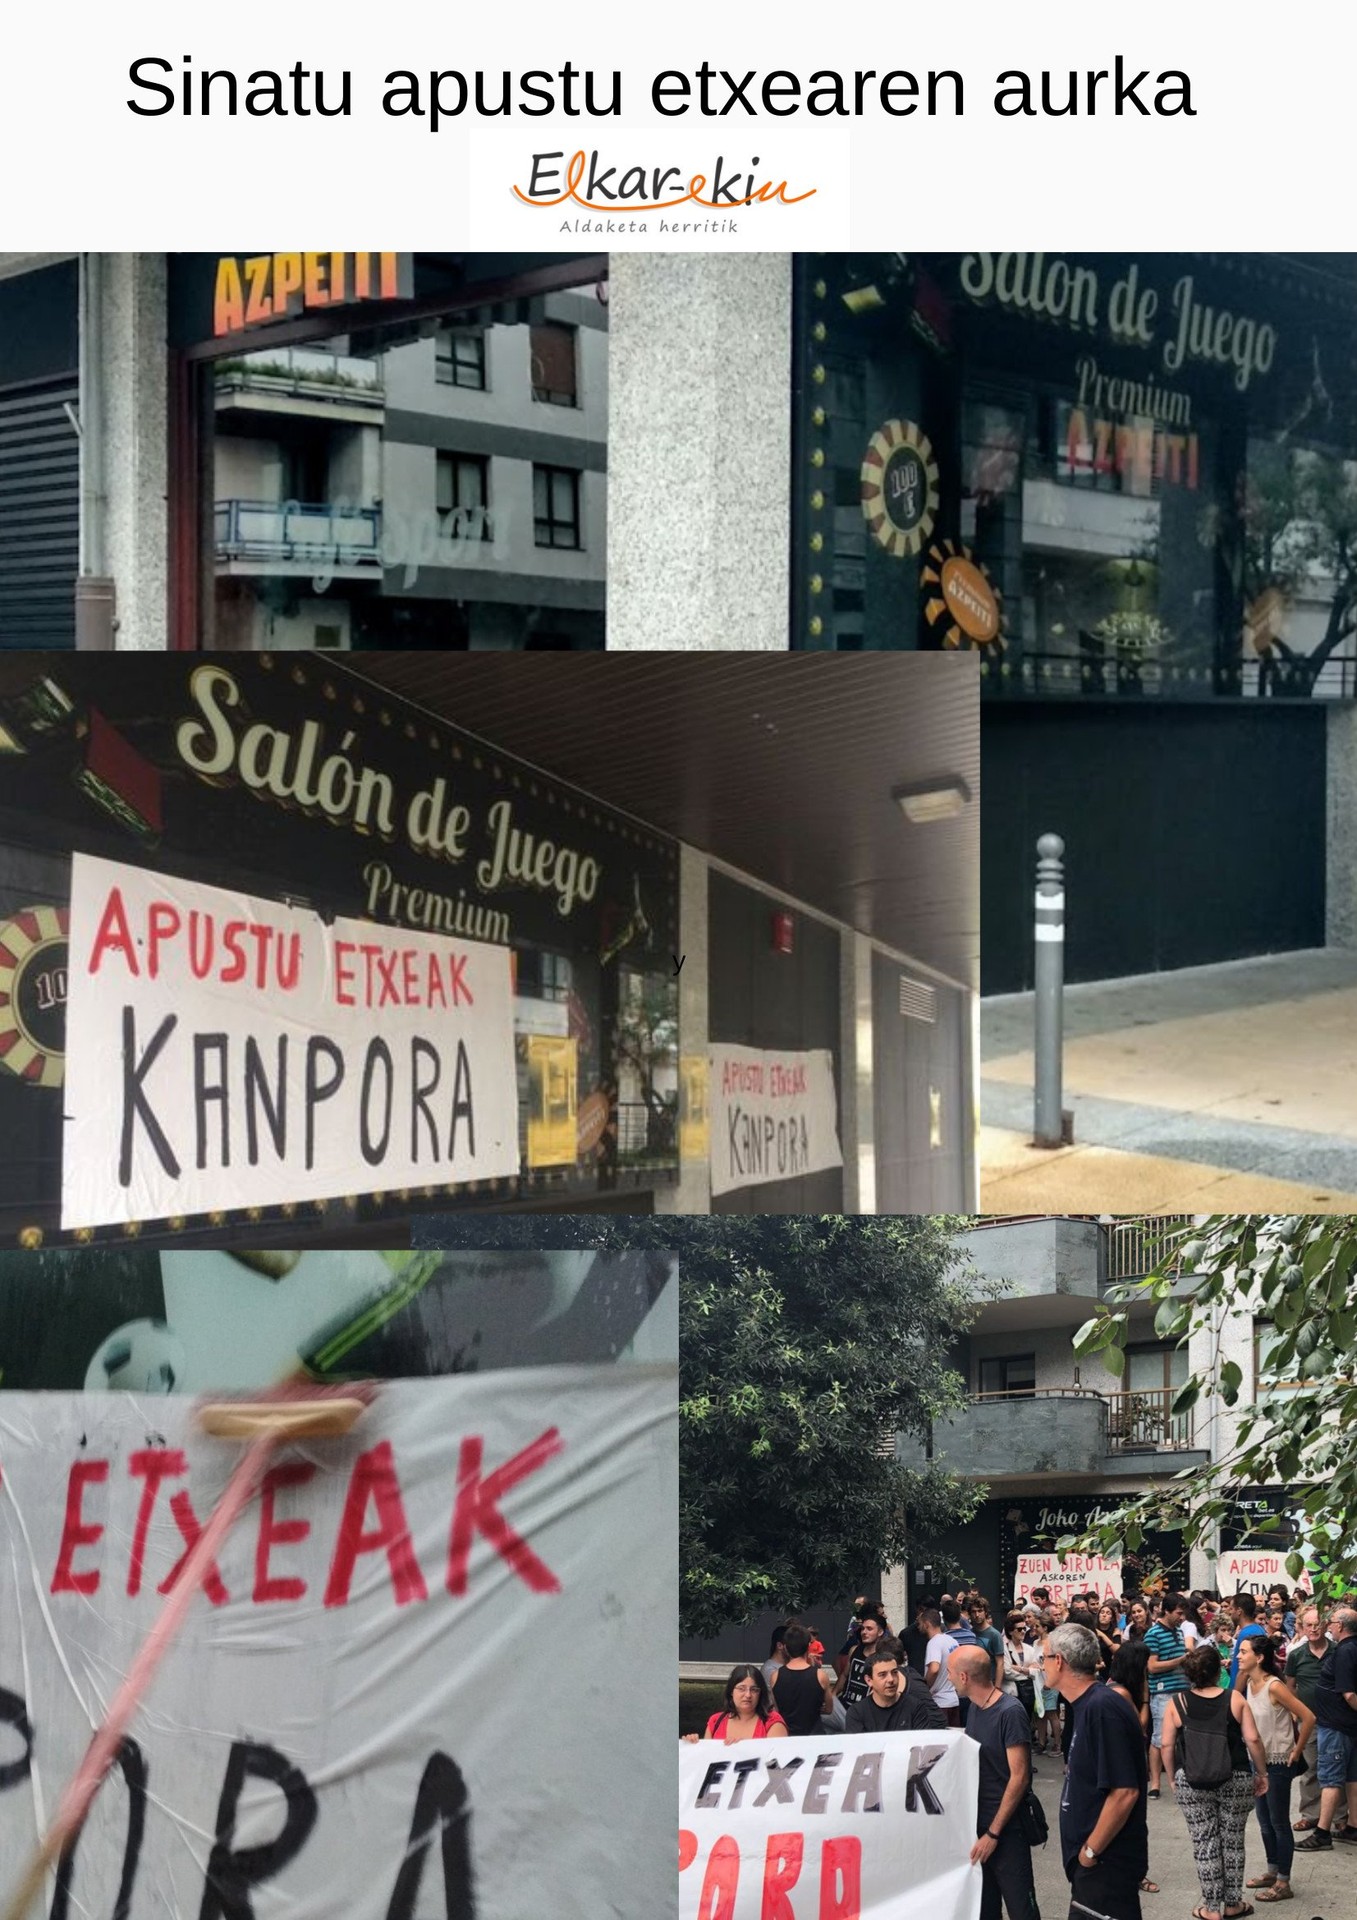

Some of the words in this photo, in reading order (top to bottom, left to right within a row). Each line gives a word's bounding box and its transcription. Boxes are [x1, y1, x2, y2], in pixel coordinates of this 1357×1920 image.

[1108, 263, 1158, 340] de
[1163, 275, 1276, 391] Juego
[1075, 356, 1192, 426] Premium
[176, 664, 395, 835] Salón
[406, 777, 472, 859] de
[477, 800, 601, 917] Juego
[363, 861, 511, 942] Premium
[88, 887, 301, 991] APUSTU
[334, 941, 474, 1008] ETXEAK
[34, 967, 67, 1010] 10
[118, 1004, 477, 1188] KANPORA
[727, 1104, 810, 1179] KANPORA
[50, 1426, 566, 1609] ETXEAK
[1035, 1507, 1079, 1532] Joko
[1019, 1558, 1051, 1575] ZUEN
[1039, 1572, 1086, 1583] ASKOREN
[1230, 1558, 1279, 1575] APUSTU
[694, 1744, 949, 1816] ETXEAK
